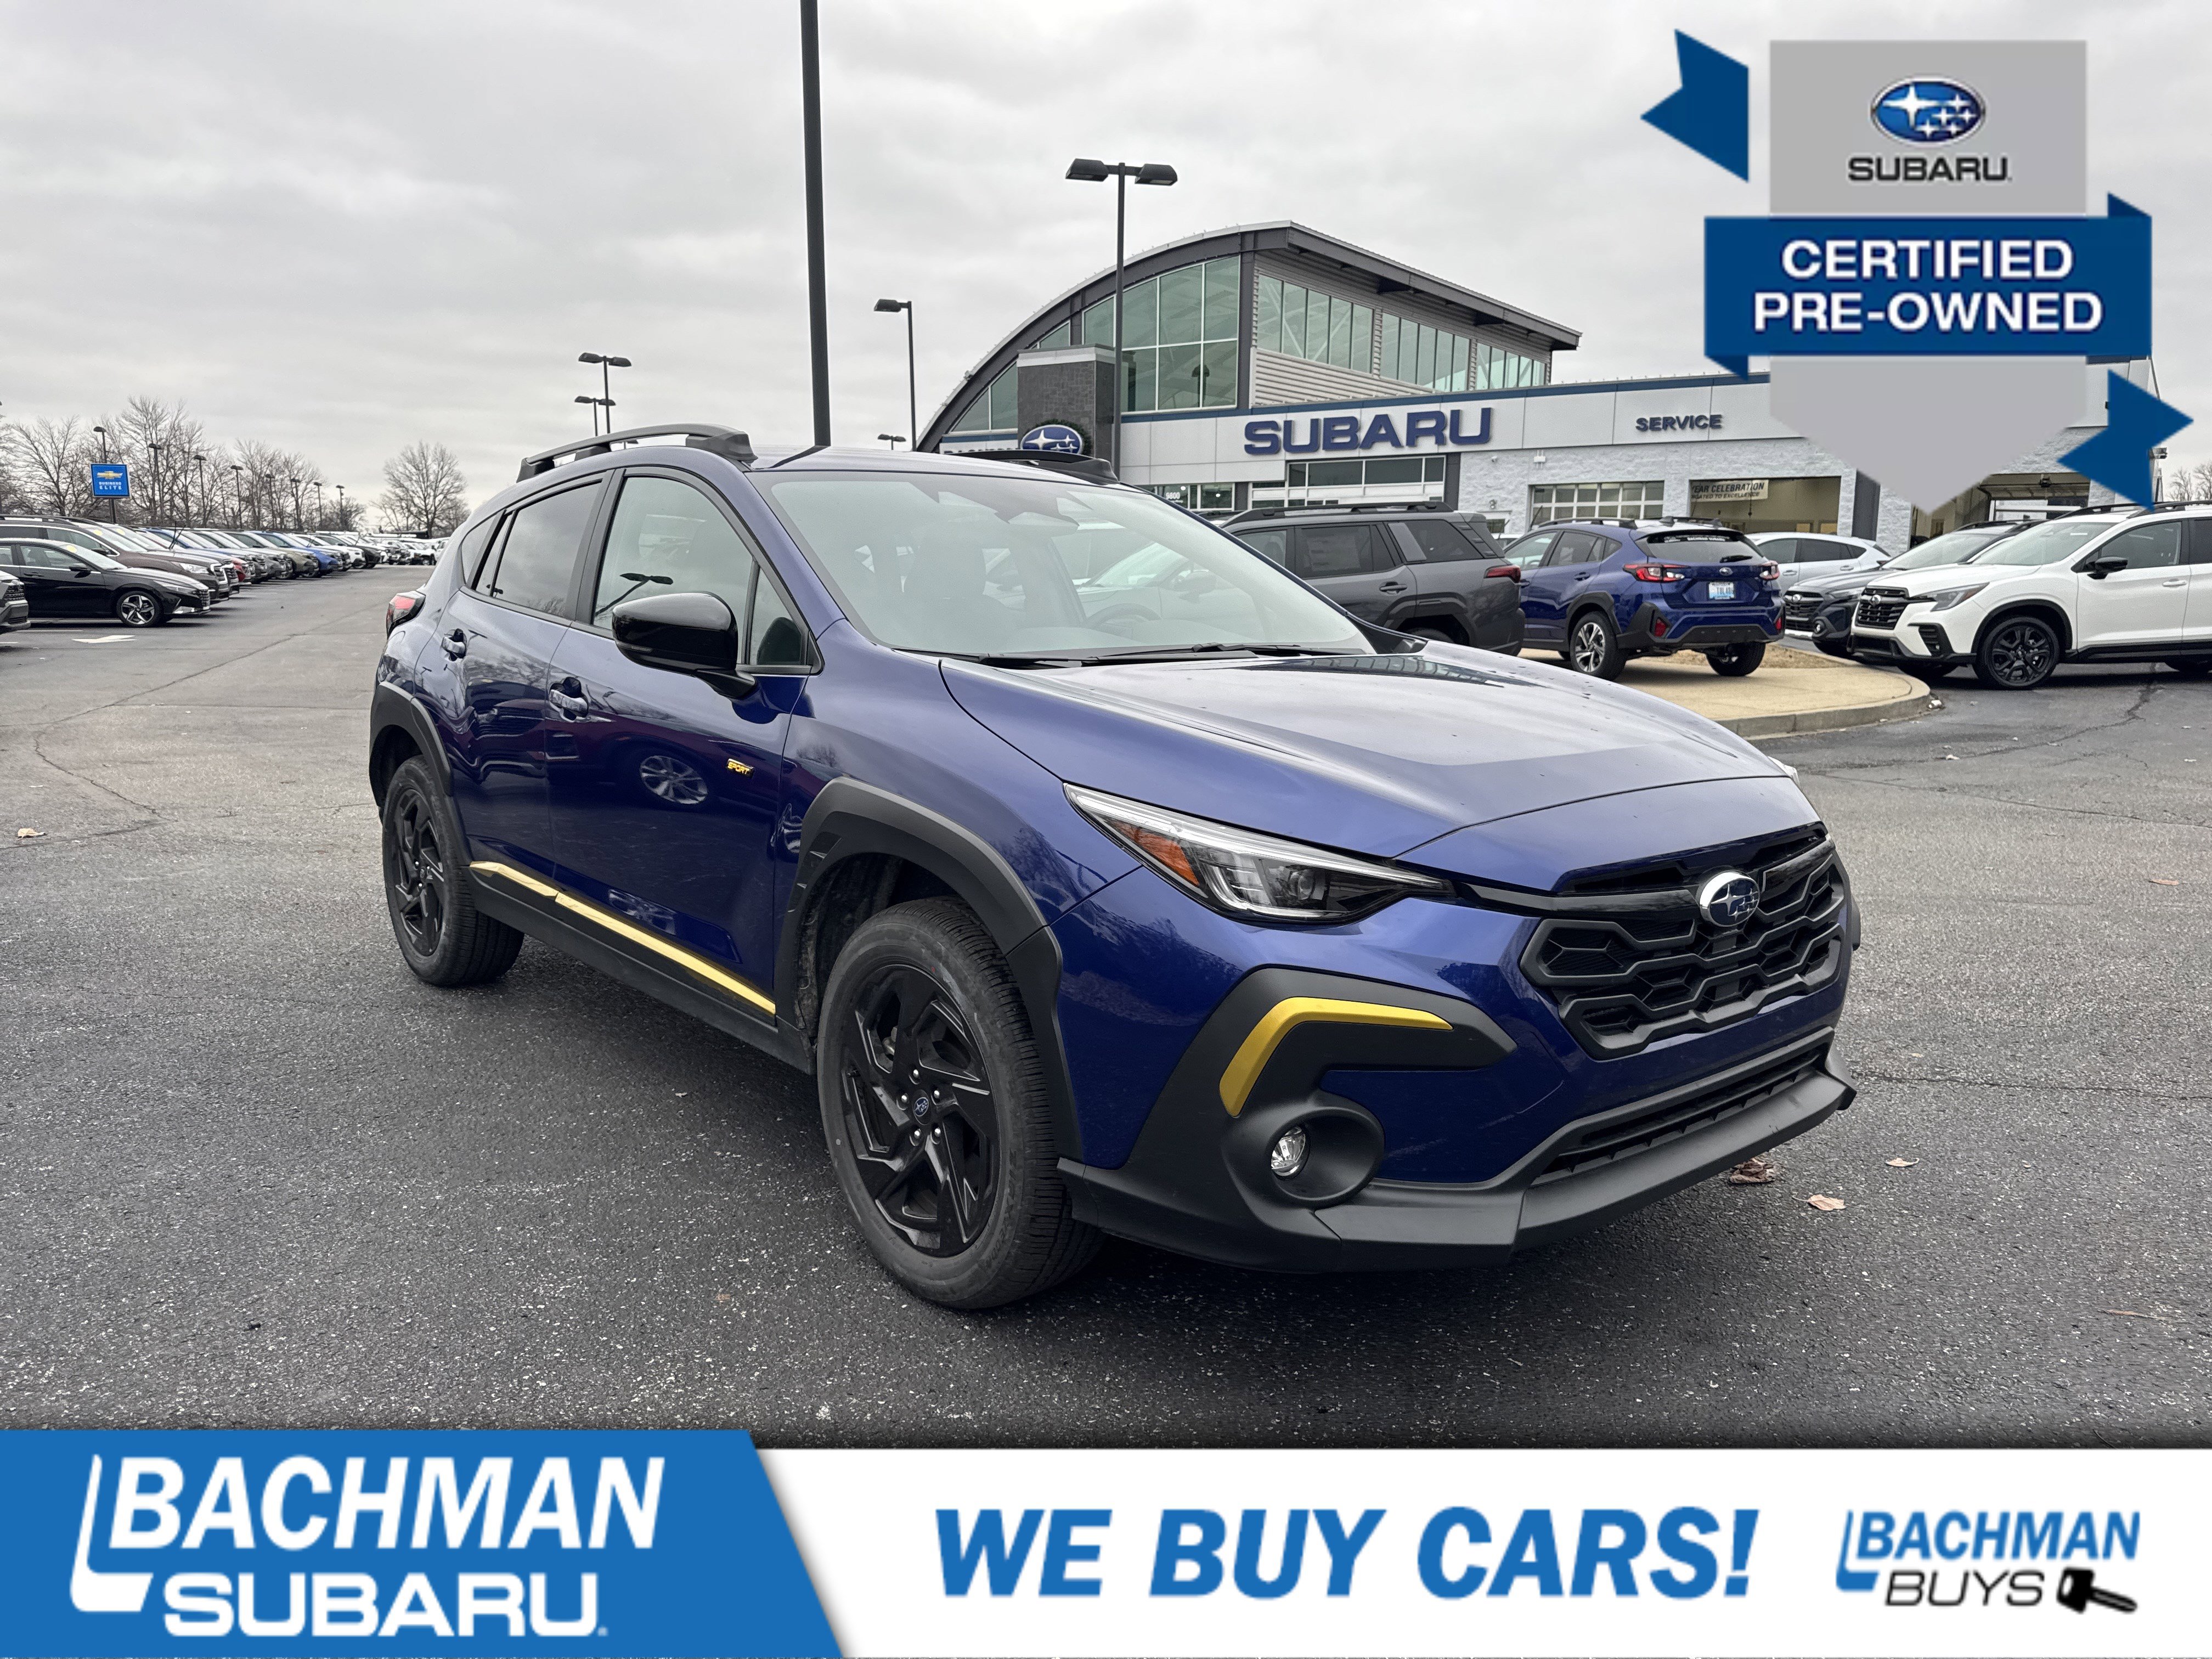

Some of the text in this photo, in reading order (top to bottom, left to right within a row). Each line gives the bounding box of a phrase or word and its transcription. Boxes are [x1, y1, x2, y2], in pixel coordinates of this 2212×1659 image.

[1635, 414, 1723, 432] SERVICE
[1244, 407, 1492, 456] SUBARU
[1711, 482, 1765, 493] CELEBRATION
[727, 761, 750, 775] SPORT
